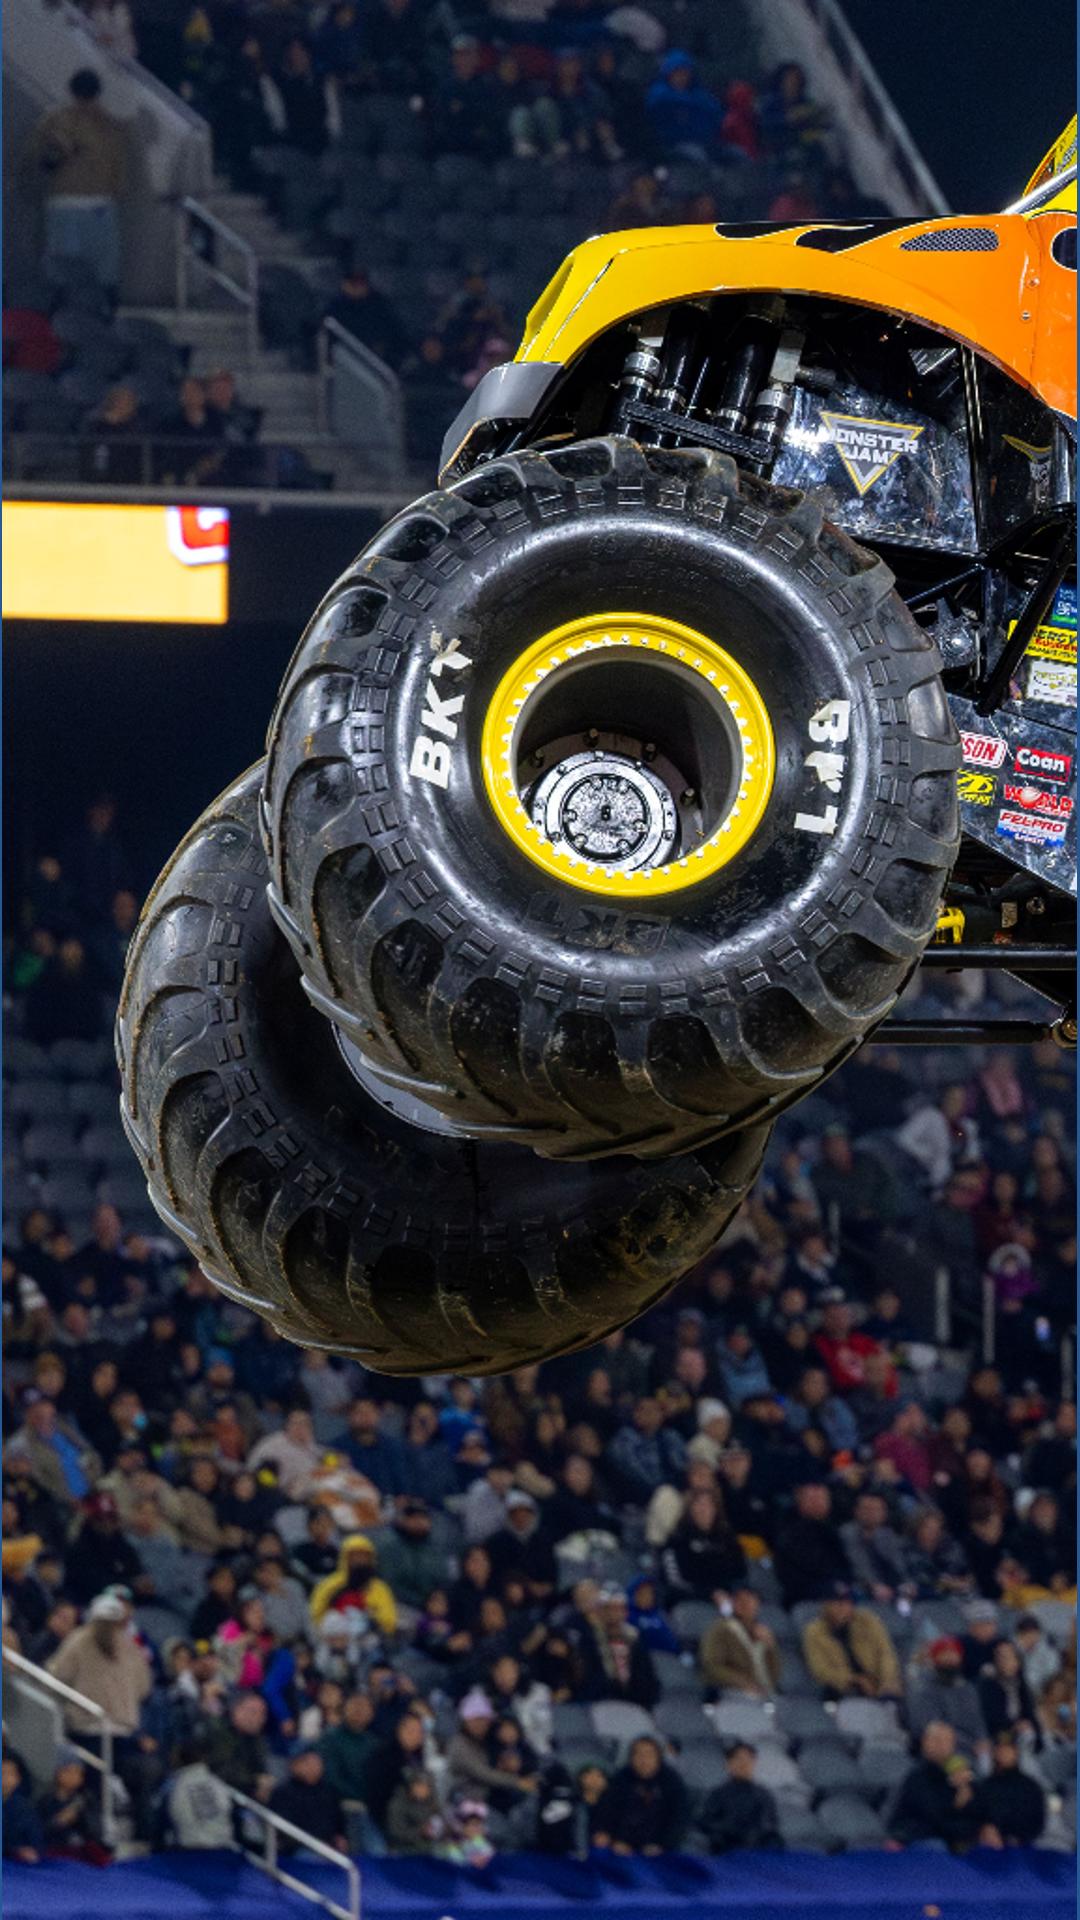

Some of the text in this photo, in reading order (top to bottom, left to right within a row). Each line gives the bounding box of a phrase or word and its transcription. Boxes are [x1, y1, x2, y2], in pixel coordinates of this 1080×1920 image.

[844, 446, 889, 464] JAM
[962, 738, 998, 761] SON
[1016, 749, 1065, 772] Coan
[1003, 784, 1073, 812] WORLD
